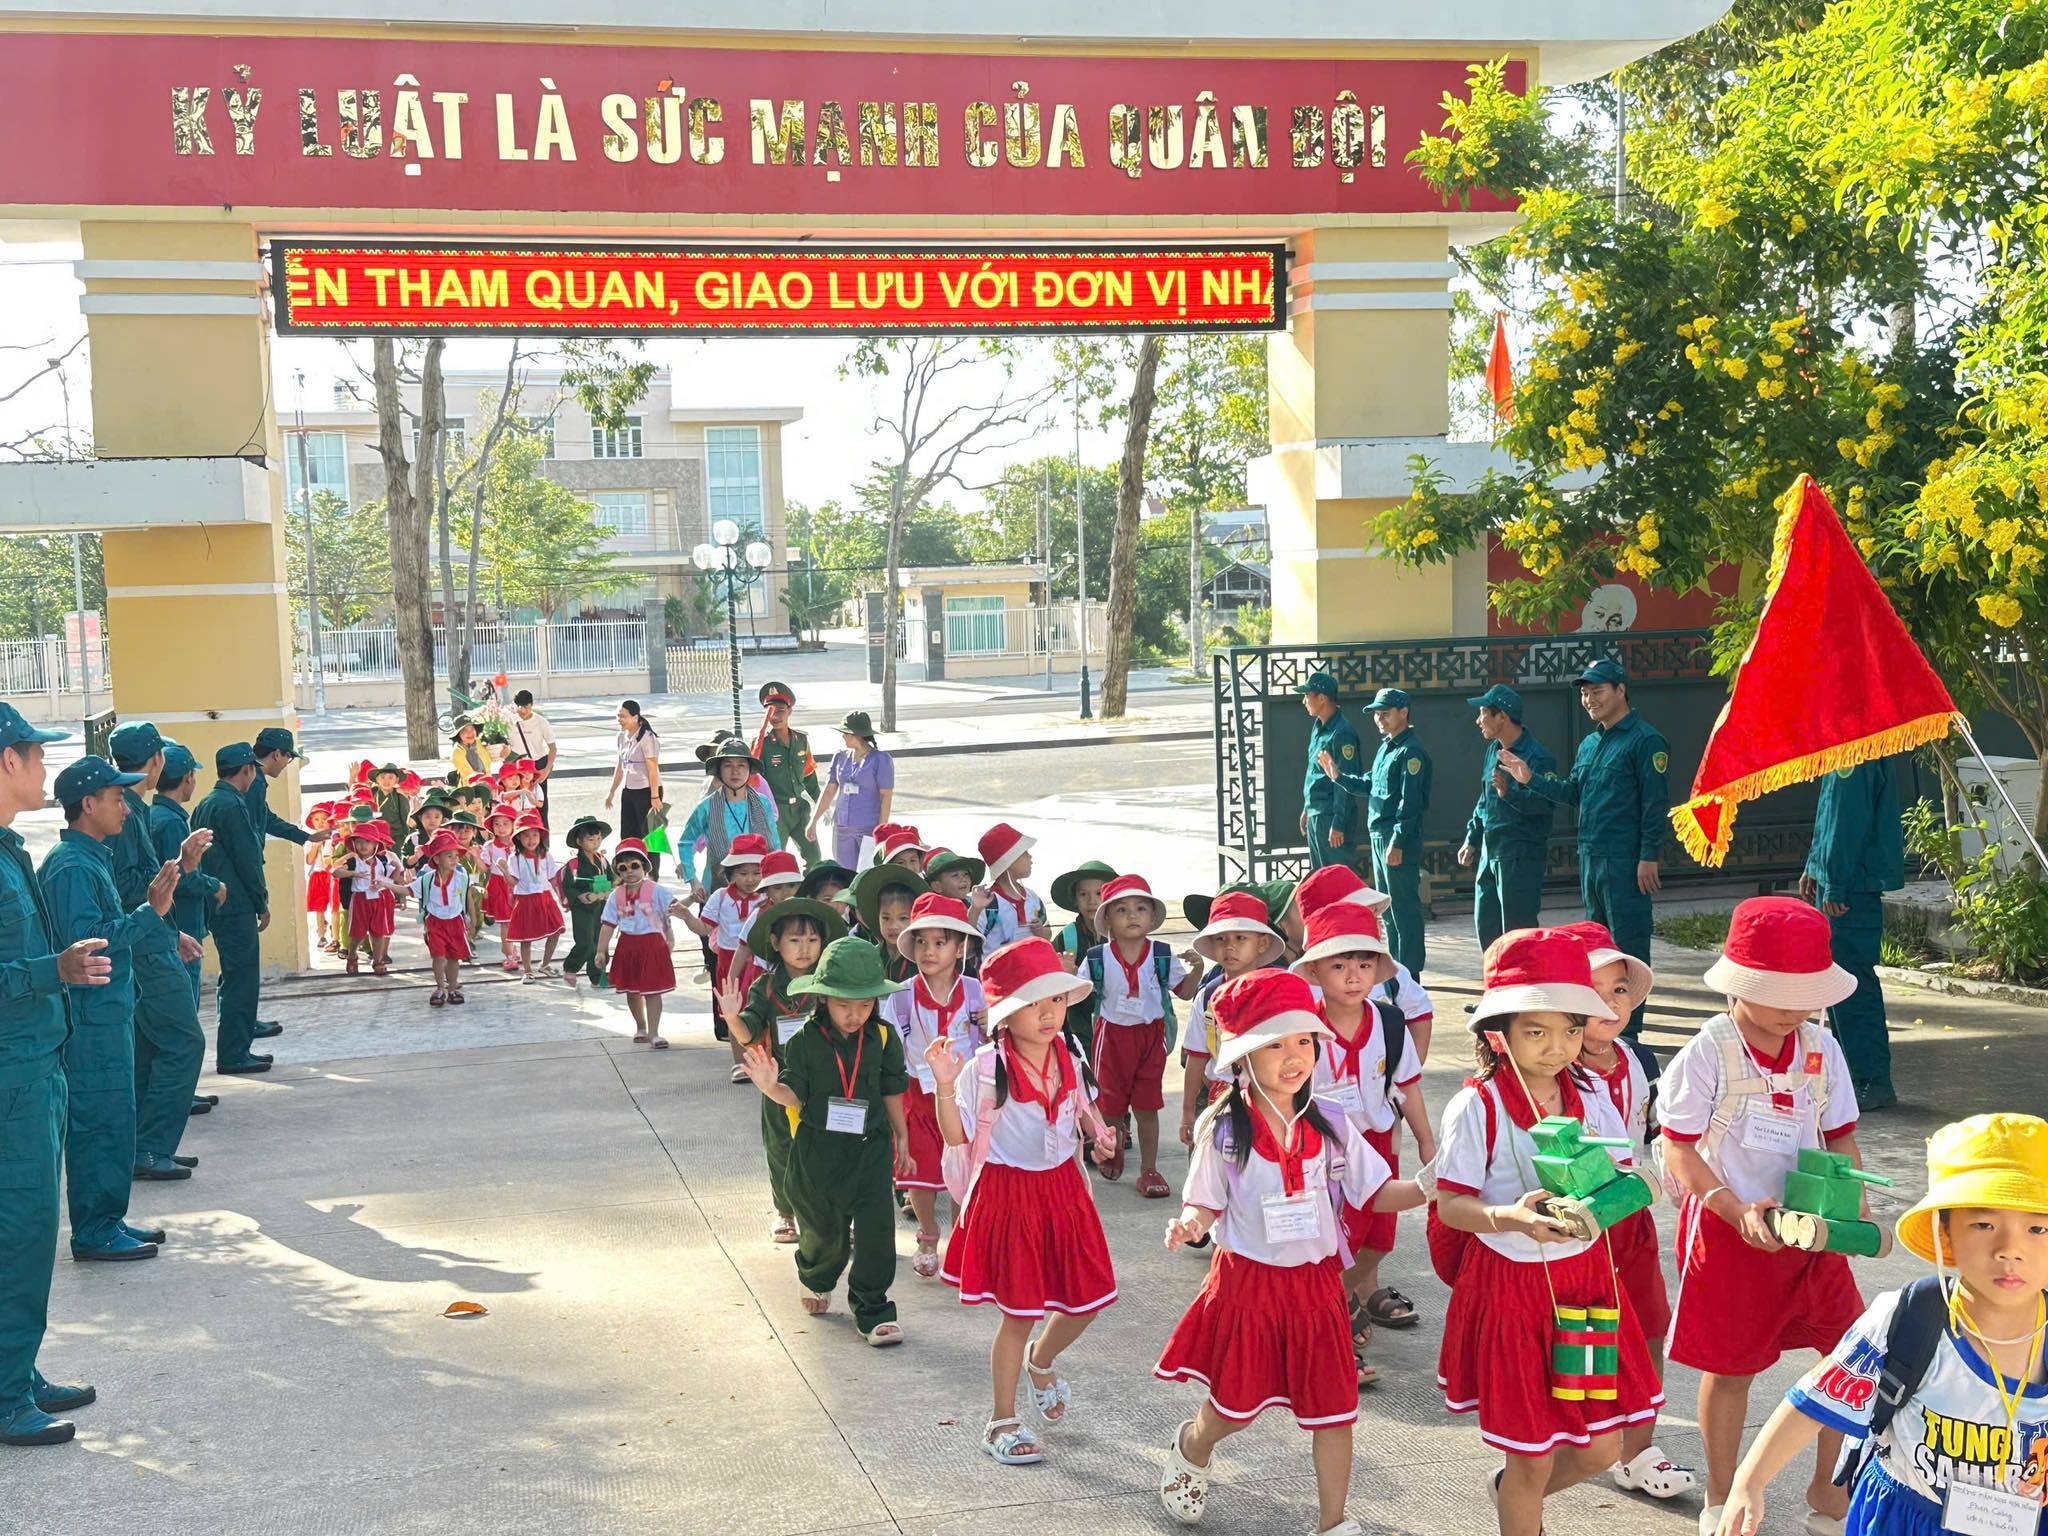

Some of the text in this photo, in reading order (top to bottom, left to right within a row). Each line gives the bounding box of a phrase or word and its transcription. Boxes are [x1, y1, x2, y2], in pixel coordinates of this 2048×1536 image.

[172, 64, 1387, 184] KỶ LUẬT LÀ SỨC MẠNH CỦA QUÂN ĐỘI
[364, 268, 510, 308] THAM
[525, 269, 679, 316] QUAN,
[695, 271, 813, 309] GIAO
[828, 271, 925, 309] LƯU
[938, 261, 1019, 308] VỚI
[1032, 270, 1133, 308] ĐƠN
[1145, 269, 1187, 316] VỊ
[1921, 1405, 2014, 1464] TUNG
